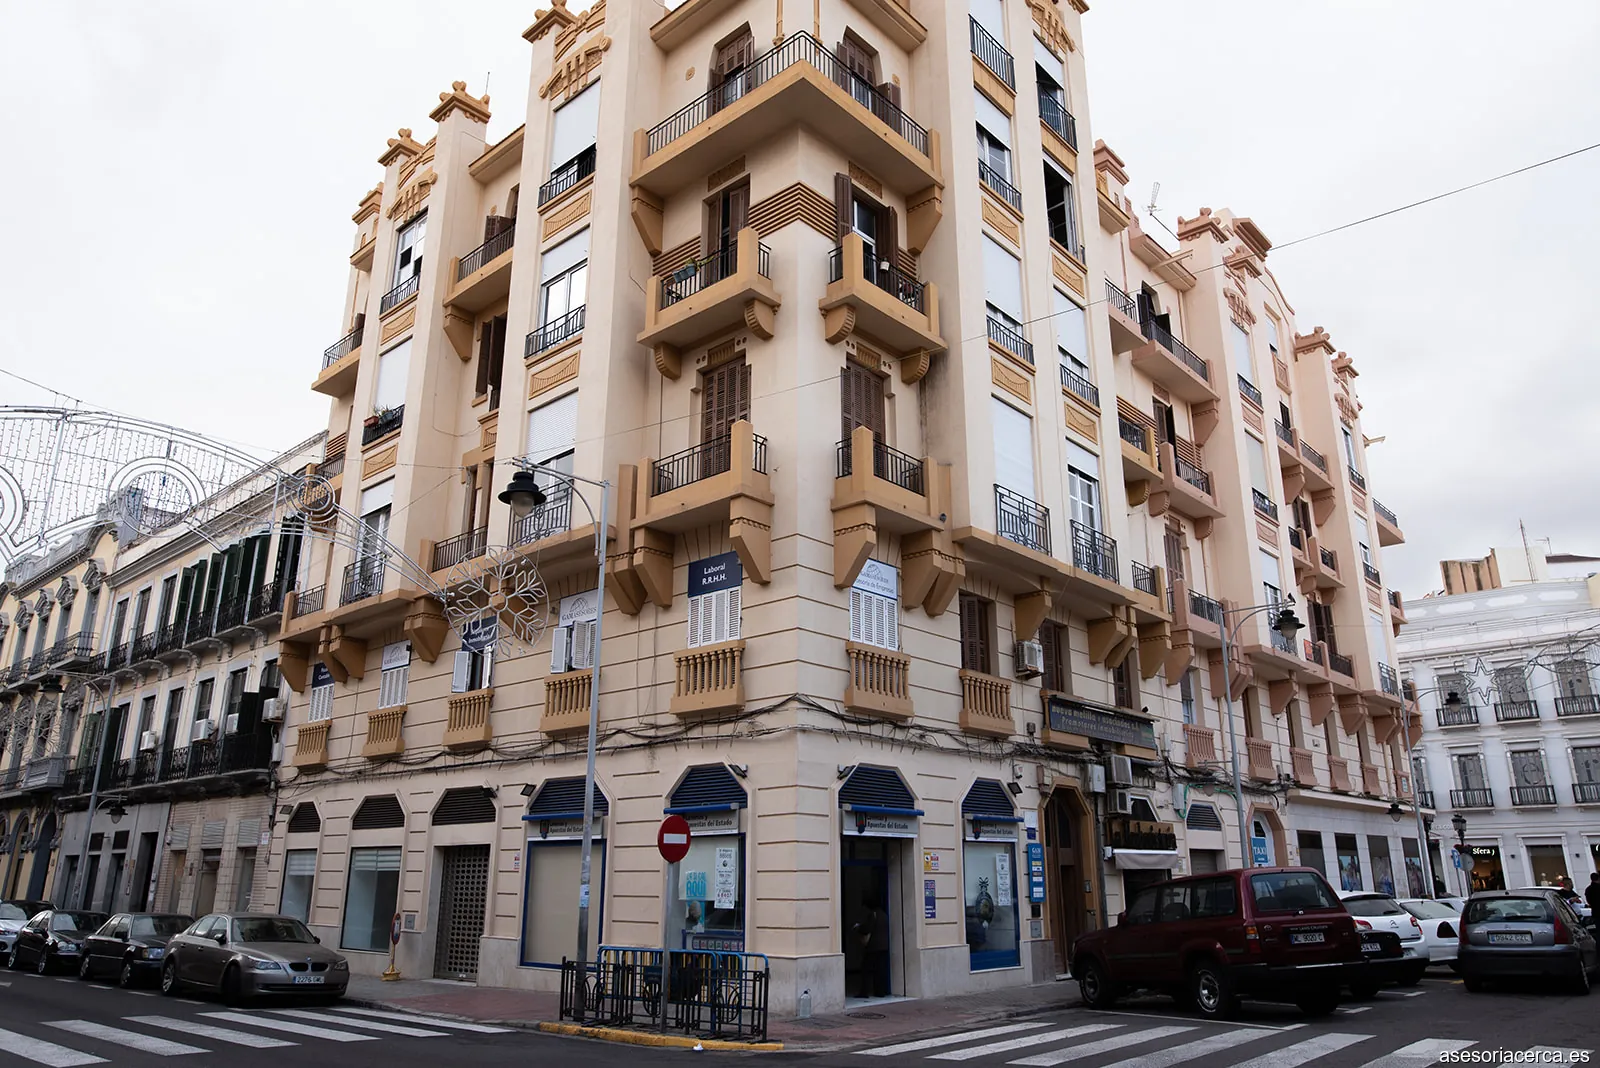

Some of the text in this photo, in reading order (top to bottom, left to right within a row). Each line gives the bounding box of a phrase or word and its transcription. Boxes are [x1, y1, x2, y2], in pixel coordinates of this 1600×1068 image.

[703, 562, 726, 574] Laboral
[702, 574, 727, 586] R.R.H.H.
[573, 824, 584, 832] Estad
[1253, 846, 1267, 856] TAXI
